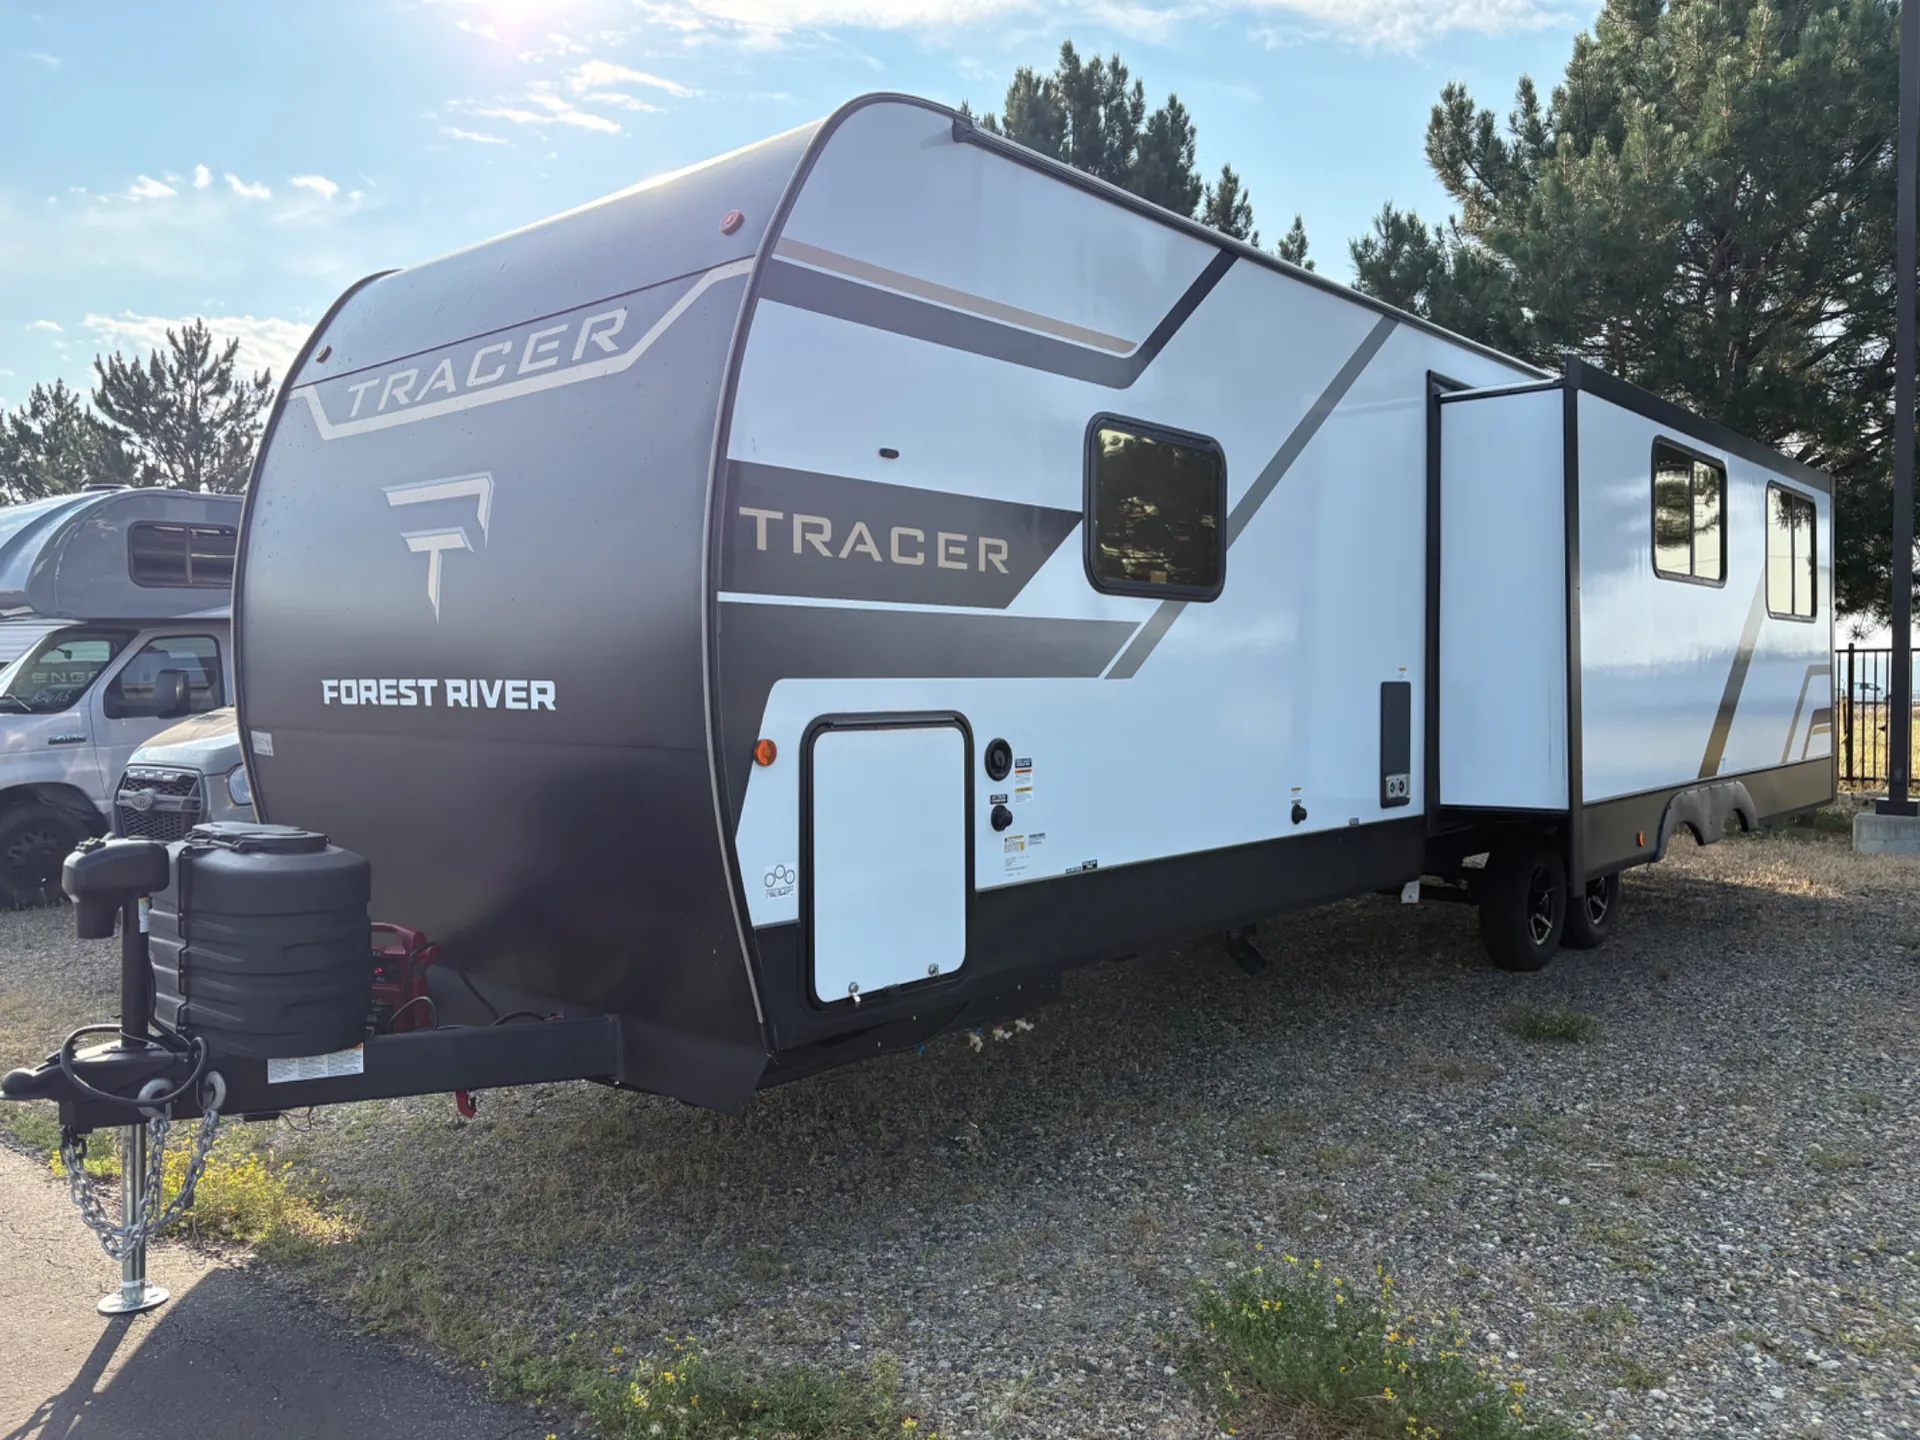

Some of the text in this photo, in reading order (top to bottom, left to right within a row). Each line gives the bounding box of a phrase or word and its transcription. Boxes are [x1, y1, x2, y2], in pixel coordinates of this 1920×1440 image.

[348, 307, 628, 417] TRACER
[738, 506, 1010, 575] TRACER
[321, 678, 557, 711] FOREST RIVER
